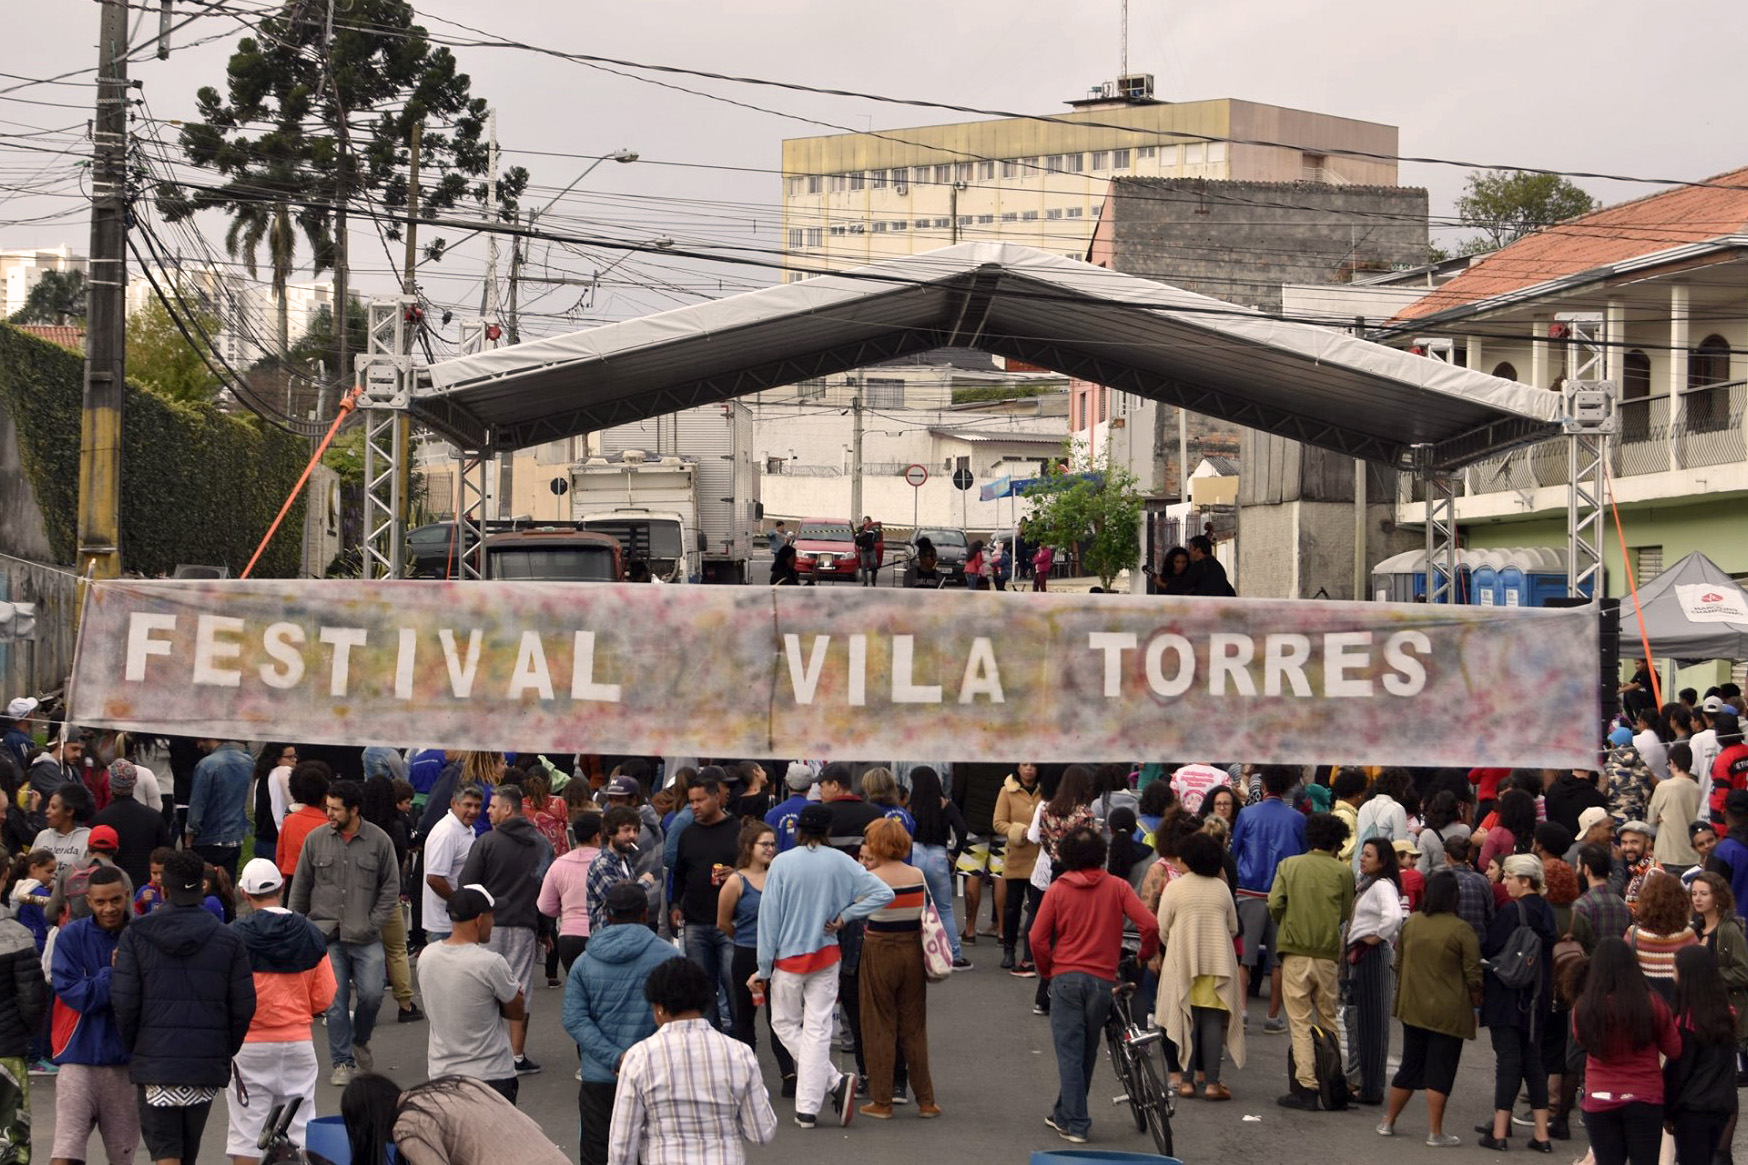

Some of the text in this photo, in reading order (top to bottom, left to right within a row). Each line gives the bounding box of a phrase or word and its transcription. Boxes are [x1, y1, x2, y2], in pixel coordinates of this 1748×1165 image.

[125, 611, 1432, 707] FESTIVAL VILA TORRES
